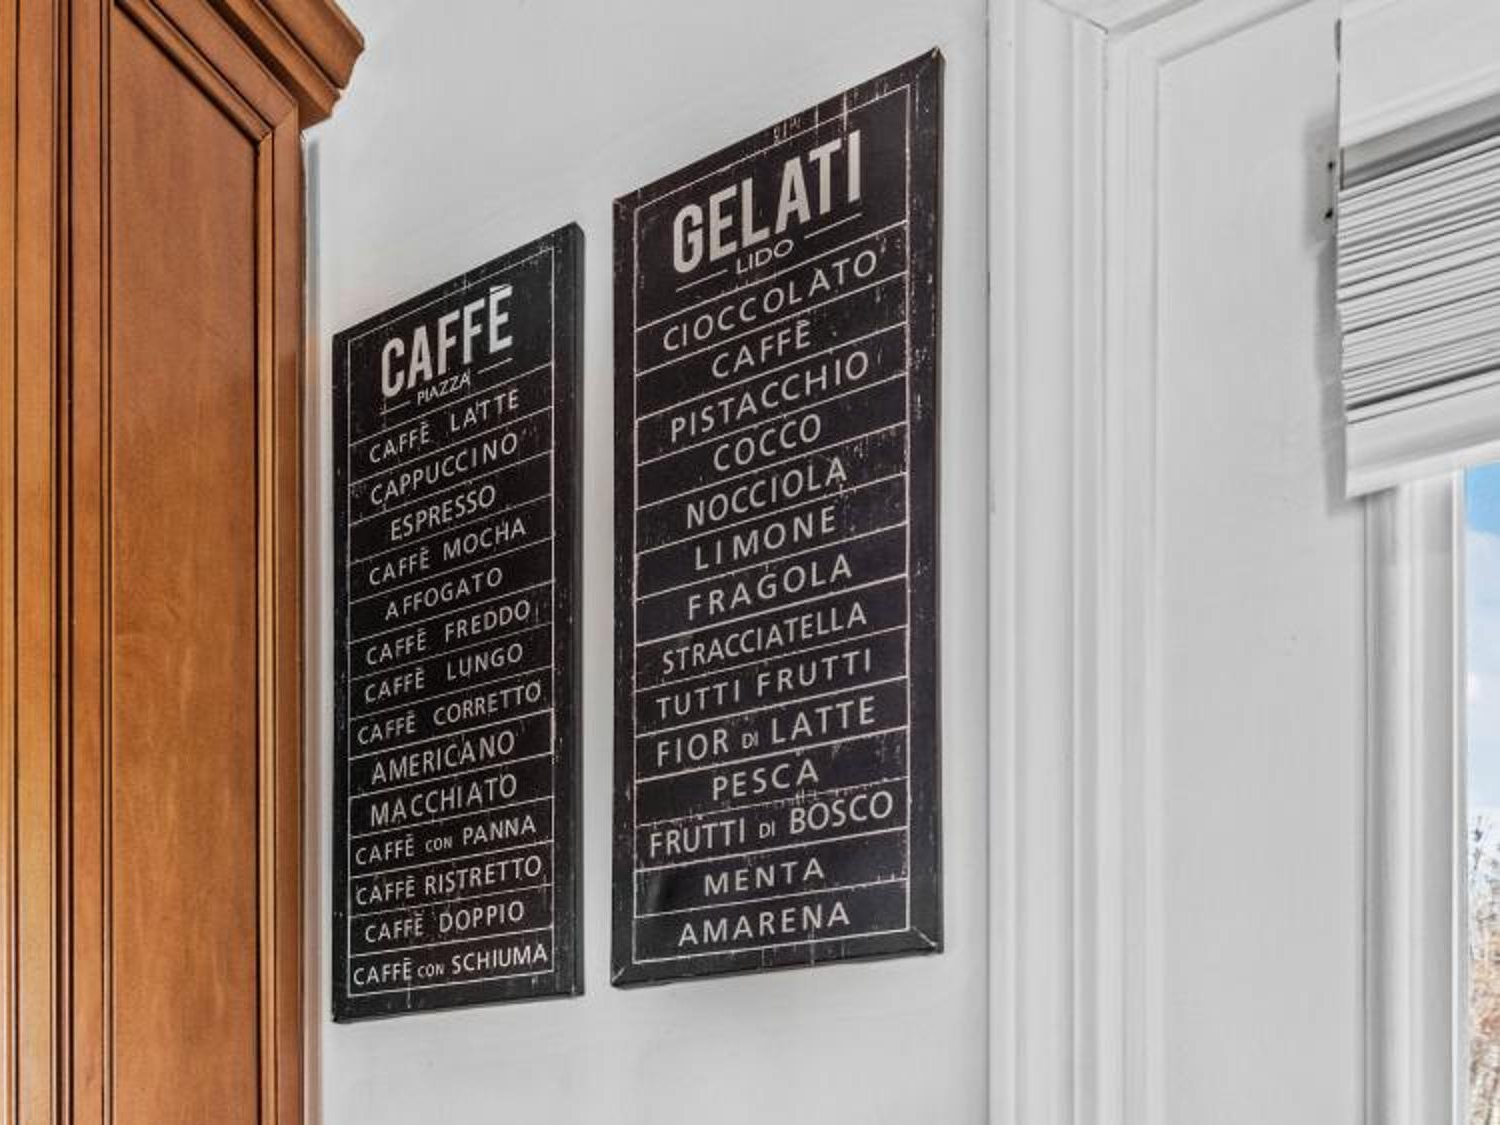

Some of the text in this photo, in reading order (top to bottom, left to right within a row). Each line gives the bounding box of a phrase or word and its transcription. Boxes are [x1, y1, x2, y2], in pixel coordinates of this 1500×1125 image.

[673, 129, 861, 274] GELATI
[735, 239, 794, 275] LIDO
[663, 250, 877, 352] CIOCCOLATO
[417, 371, 471, 405] PIAZZA
[450, 389, 520, 433] LATTE
[670, 351, 869, 443] PISTACCHIO
[370, 432, 519, 506] CAPPUCCINO
[713, 413, 821, 472] COCCO
[391, 485, 496, 541] ESPRESSO
[686, 456, 847, 529] NOCCIOLA
[442, 516, 527, 562] MOCHA
[694, 506, 837, 571] LIMONE
[385, 566, 503, 621] AFFOGATO
[688, 553, 852, 621] FRAGOLA
[445, 599, 531, 644] FREDDO
[662, 601, 867, 675] STRACCIATELLA
[447, 643, 523, 681] LUNGO
[656, 648, 871, 720] TUTTI FRUTTI
[432, 681, 541, 726] CORRETTO
[371, 731, 515, 785] AMERICANO
[656, 728, 729, 767] FIOR
[771, 696, 875, 744] LATTE
[370, 774, 517, 828] MACCHIATO
[712, 758, 819, 801] PESCA
[425, 836, 453, 853] CON
[462, 815, 537, 846] PANNA
[650, 818, 745, 859] FRUTTI
[789, 790, 893, 834] BOSCO
[425, 855, 542, 896] RISTRETTO
[703, 857, 825, 897] MENTA
[439, 901, 525, 934] DOPPIO
[677, 901, 850, 947] AMARENA
[417, 963, 445, 979] CON
[451, 944, 548, 975] SCHIUMA
